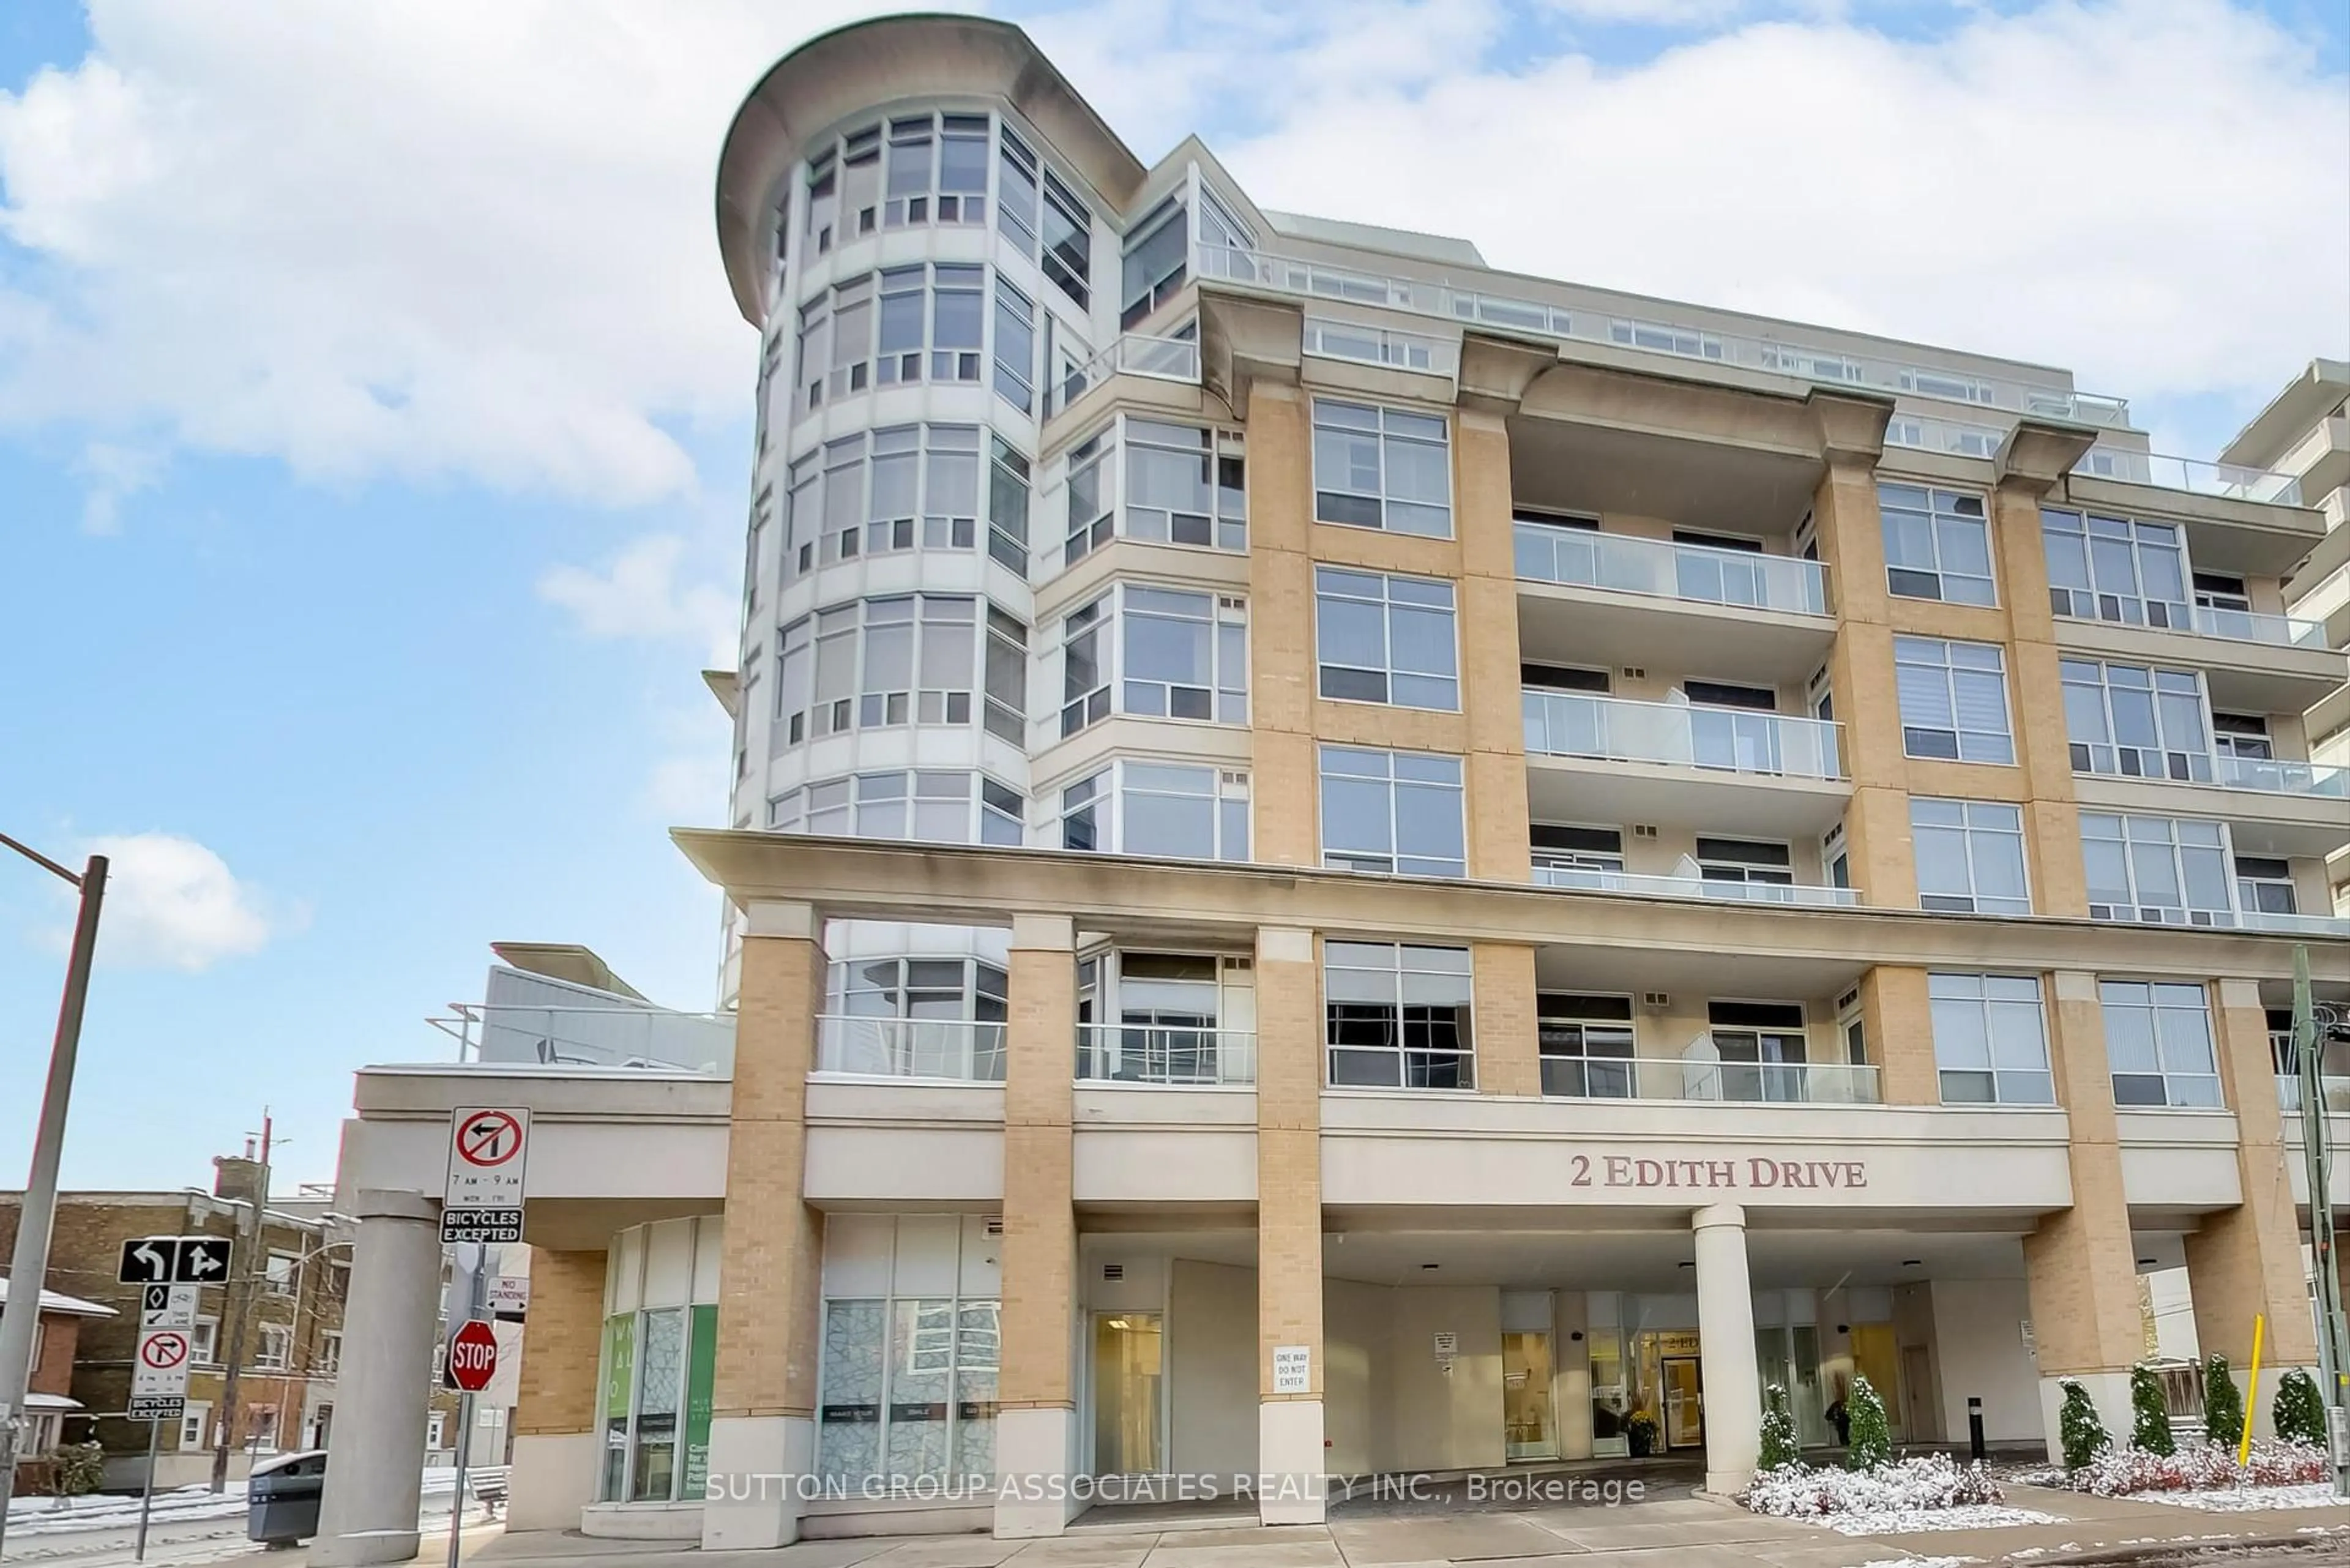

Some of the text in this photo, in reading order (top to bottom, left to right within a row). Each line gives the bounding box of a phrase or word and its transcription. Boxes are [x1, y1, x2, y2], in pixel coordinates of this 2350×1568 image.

[1570, 1155, 1592, 1186] 2
[452, 1174, 460, 1185] 7
[494, 1175, 501, 1185] 9
[506, 1177, 519, 1185] AM
[446, 1212, 519, 1225] BICYCLES
[444, 1228, 518, 1241] EXCEPTED
[501, 1280, 516, 1290] NO
[489, 1290, 527, 1300] STANDING
[454, 1341, 494, 1370] STOP
[1276, 1353, 1307, 1362] ONE WAY
[1278, 1365, 1305, 1374] DO NOT
[1280, 1377, 1304, 1386] ENTER
[133, 1398, 182, 1408] BICYCLES
